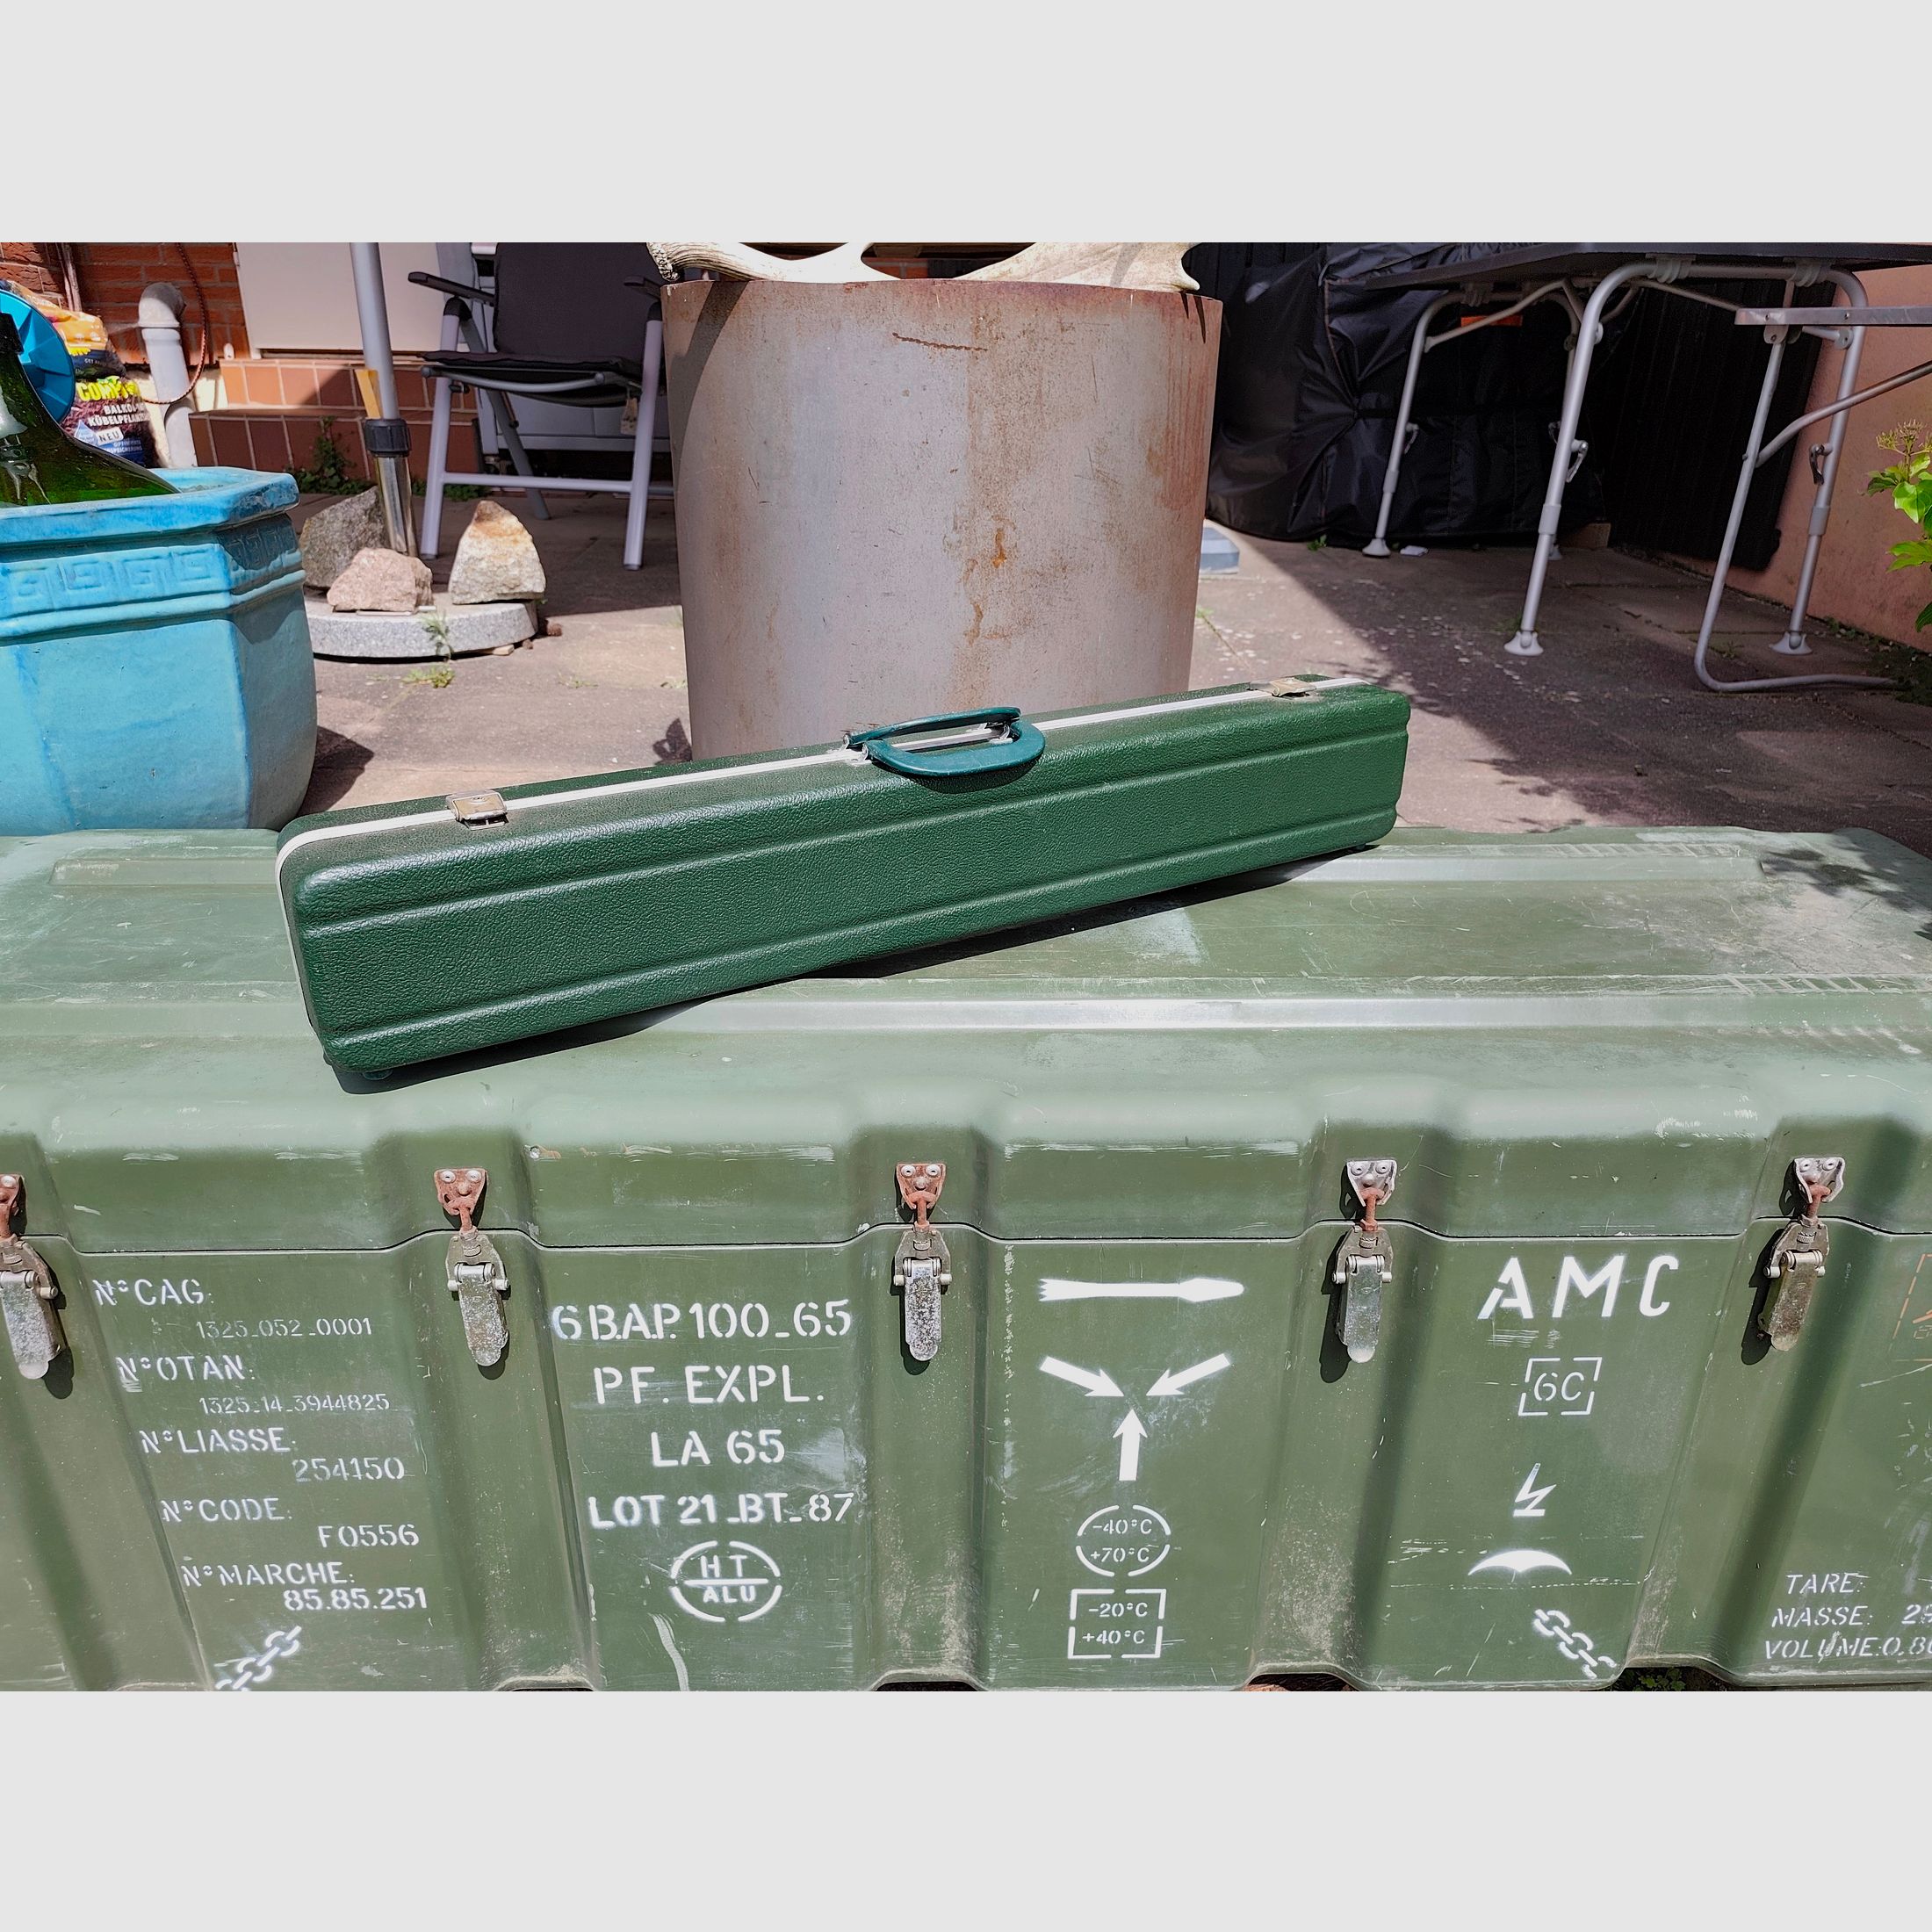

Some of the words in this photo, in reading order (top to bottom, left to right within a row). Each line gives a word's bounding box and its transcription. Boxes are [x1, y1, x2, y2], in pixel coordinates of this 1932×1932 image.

[98, 431, 120, 442] NEU
[1477, 1254, 1679, 1320] AMC
[593, 1366, 670, 1405] PF.
[684, 1364, 825, 1404] EXPL.
[1533, 1372, 1585, 1402] 6C
[651, 1431, 710, 1467] LA
[726, 1429, 785, 1464] 65
[292, 1457, 404, 1482] 254150
[588, 1495, 666, 1530] LOT
[1092, 1518, 1153, 1535] -40°C
[1090, 1546, 1150, 1563] +70°C
[703, 1585, 756, 1604] ALU
[1785, 1572, 1864, 1595] TARE:
[283, 1587, 428, 1611] 85.85.251
[1088, 1602, 1148, 1618] -20°C
[1771, 1605, 1873, 1627] MASSE:
[1082, 1630, 1145, 1645] +40°C
